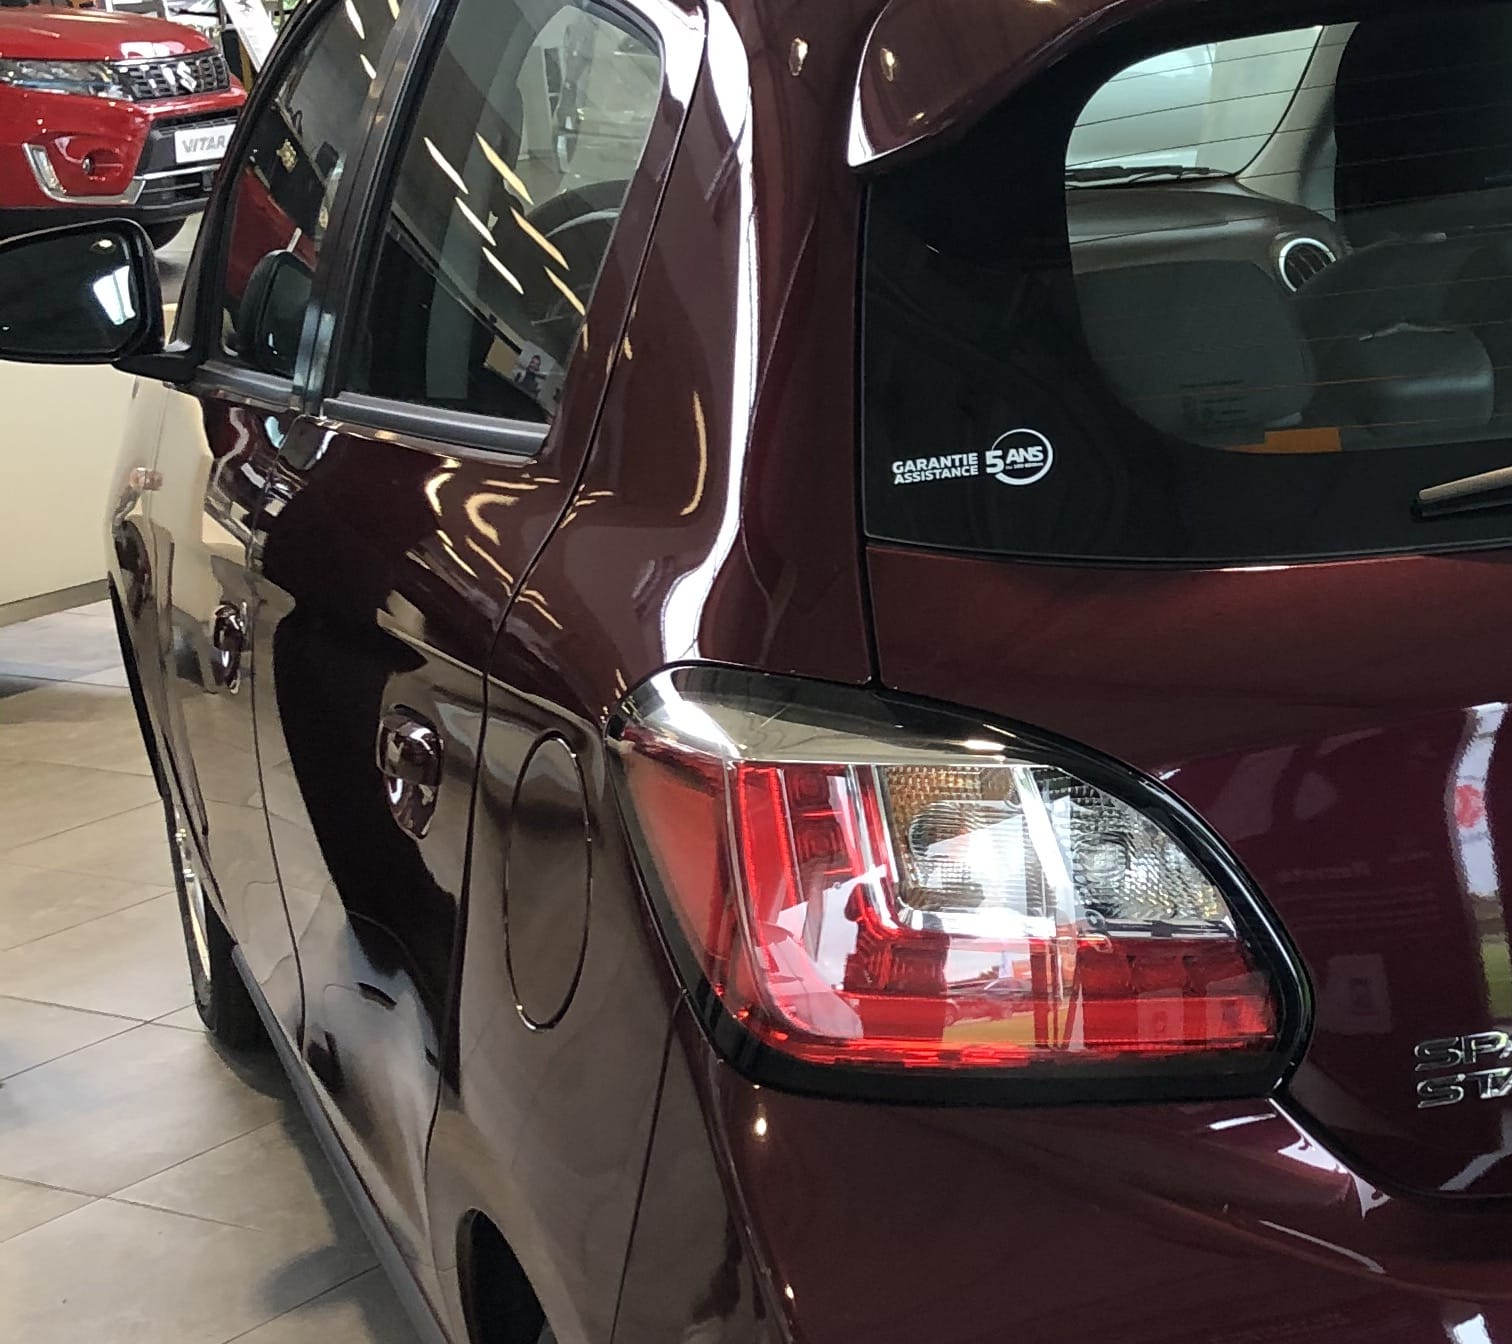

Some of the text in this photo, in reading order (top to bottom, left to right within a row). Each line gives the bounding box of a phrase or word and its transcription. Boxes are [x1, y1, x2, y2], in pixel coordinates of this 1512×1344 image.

[182, 135, 227, 153] VITAR
[892, 445, 1045, 474] GARANTIE 5 ANS
[893, 465, 979, 485] ASSISTANCE
